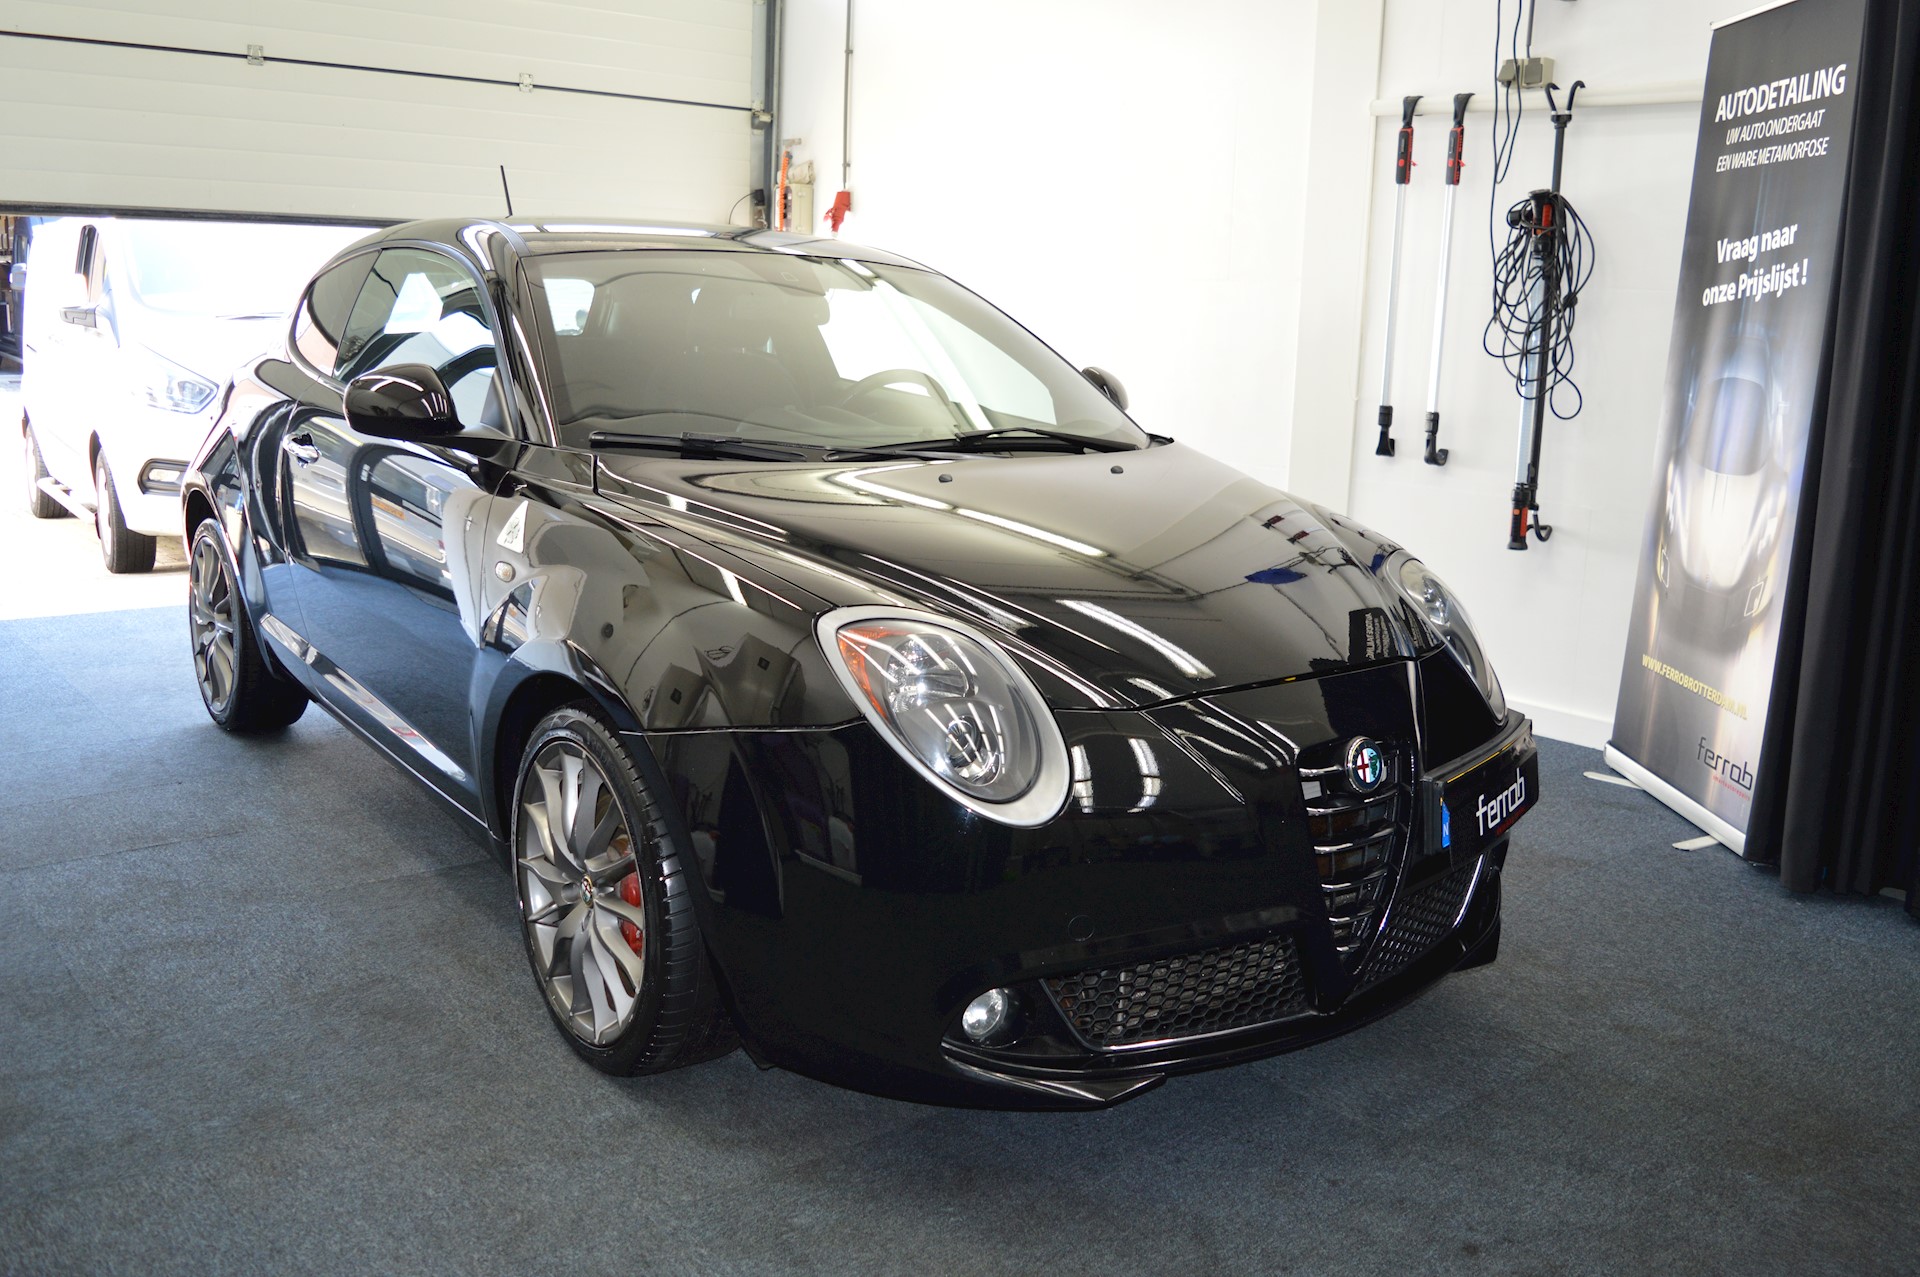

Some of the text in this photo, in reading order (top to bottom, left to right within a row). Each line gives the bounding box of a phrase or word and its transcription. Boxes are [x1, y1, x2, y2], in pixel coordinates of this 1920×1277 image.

[1715, 64, 1847, 122] AUTODETAILING
[1725, 109, 1825, 145] UW AUTO ONDERGAAT
[1716, 137, 1829, 172] EEN WARE METAMORFOSE
[1717, 224, 1798, 263] Vraag naar
[1702, 282, 1736, 306] onze
[1738, 262, 1799, 302] Prijslijst
[1698, 736, 1753, 790] ferrob
[1476, 767, 1525, 836] ferrob
